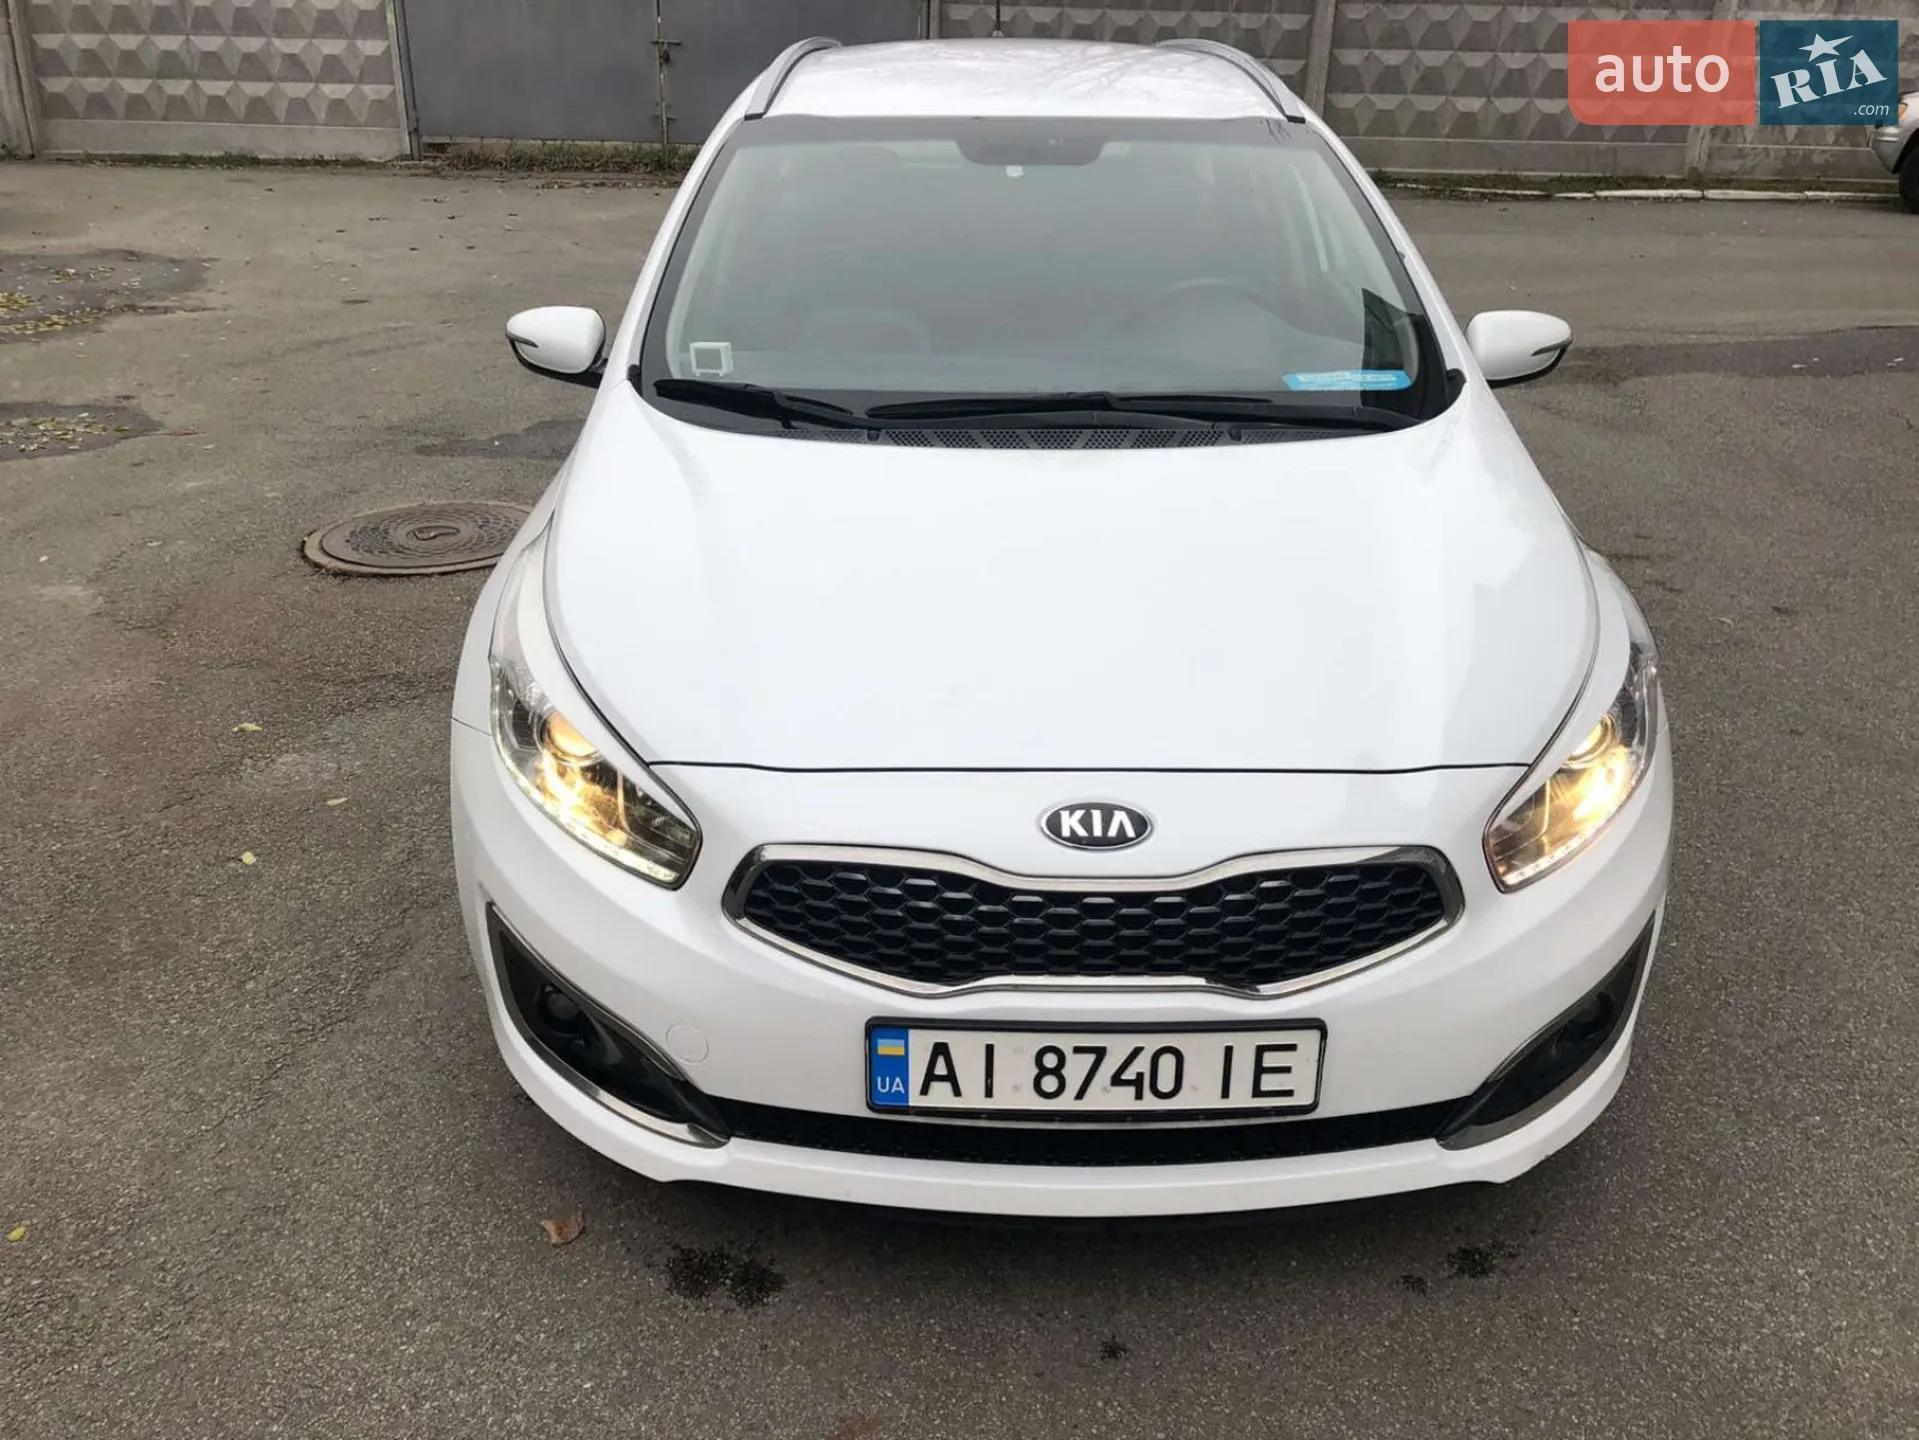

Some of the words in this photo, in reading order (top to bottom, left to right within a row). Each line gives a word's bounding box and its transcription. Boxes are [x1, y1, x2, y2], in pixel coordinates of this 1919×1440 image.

[1059, 809, 1137, 838] KIA
[876, 1076, 905, 1095] UA
[919, 1041, 995, 1099] AI
[1032, 1044, 1185, 1101] 8740
[1220, 1042, 1299, 1099] IE
